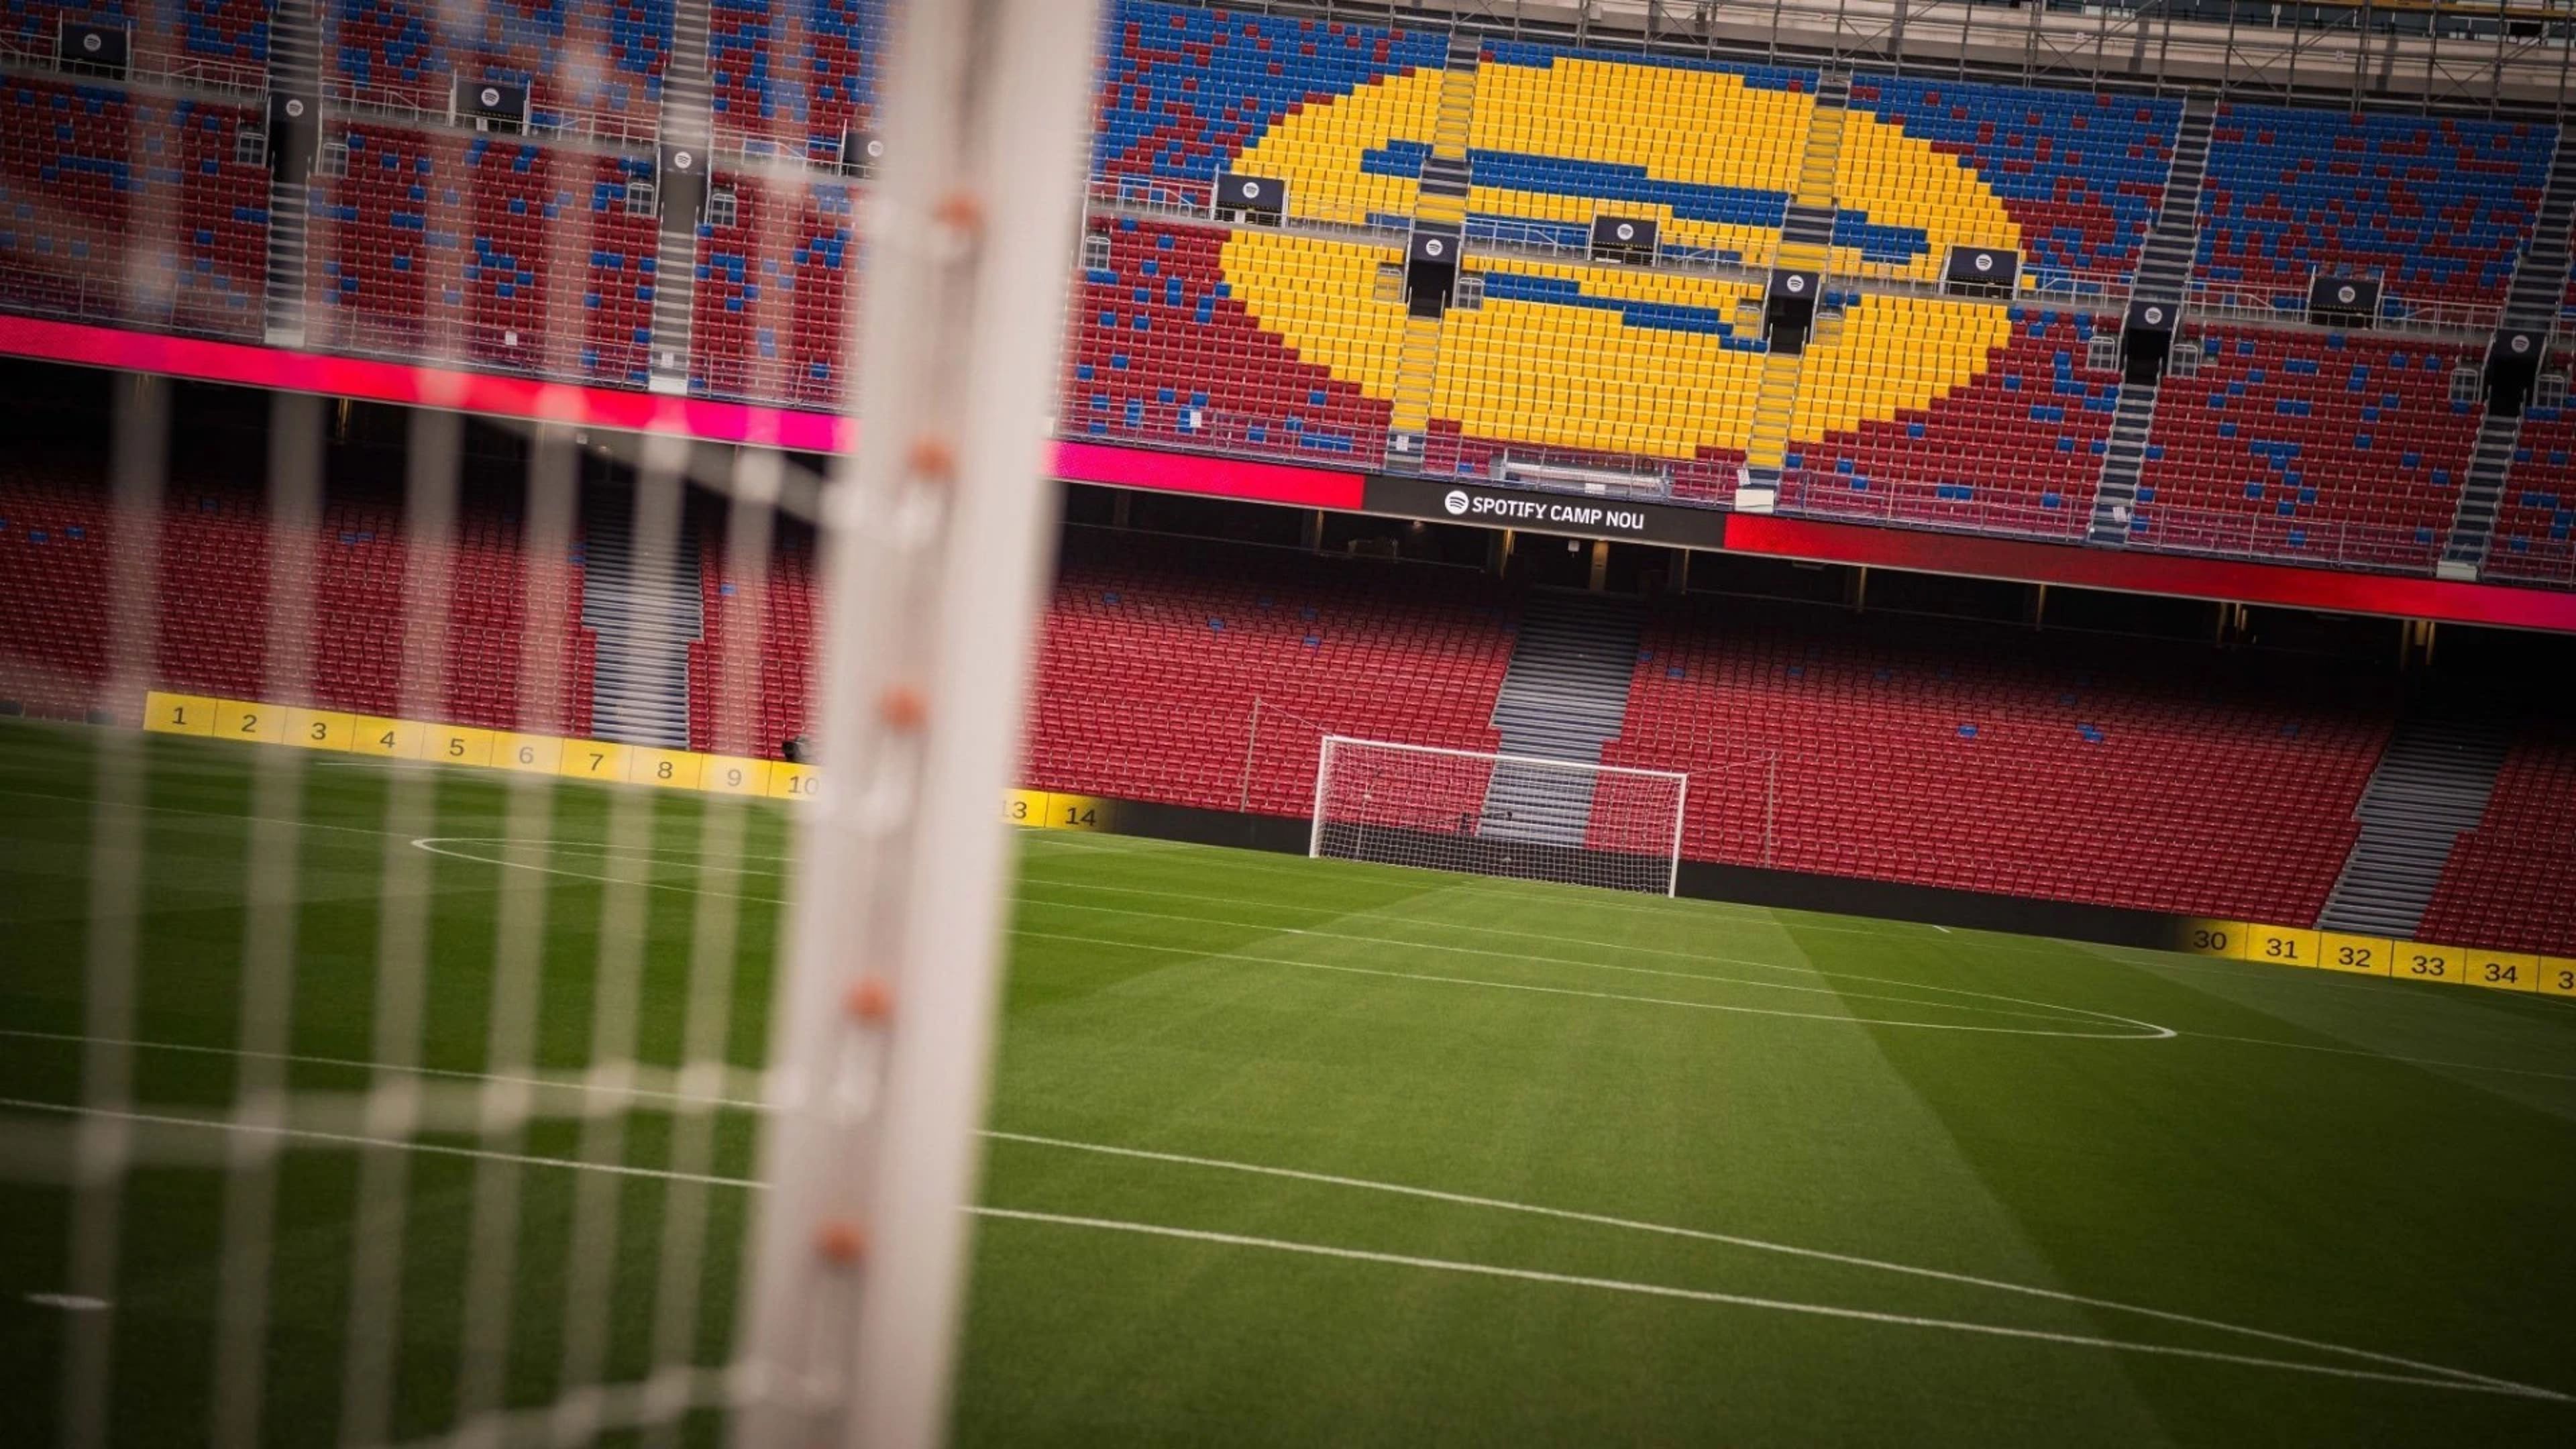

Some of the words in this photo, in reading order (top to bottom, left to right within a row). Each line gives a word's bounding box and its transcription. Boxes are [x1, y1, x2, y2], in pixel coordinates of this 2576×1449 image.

[1472, 496, 1548, 519] SPOTIFY
[1550, 505, 1602, 525] CAMP
[1605, 511, 1644, 529] NOU
[170, 706, 186, 724] 1
[241, 714, 258, 733] 2
[311, 722, 327, 740] 3
[380, 731, 396, 748] 4
[449, 739, 465, 757] 5
[519, 747, 535, 764] 6
[588, 753, 604, 771] 7
[657, 761, 674, 779] 8
[727, 769, 742, 786] 9
[788, 775, 820, 795] 10
[1065, 807, 1097, 826] 14
[2193, 930, 2227, 951] 30
[2265, 938, 2299, 959] 31
[2338, 947, 2371, 967] 32
[2411, 955, 2445, 976] 33
[2484, 963, 2519, 984] 34
[2558, 971, 2575, 989] 3
